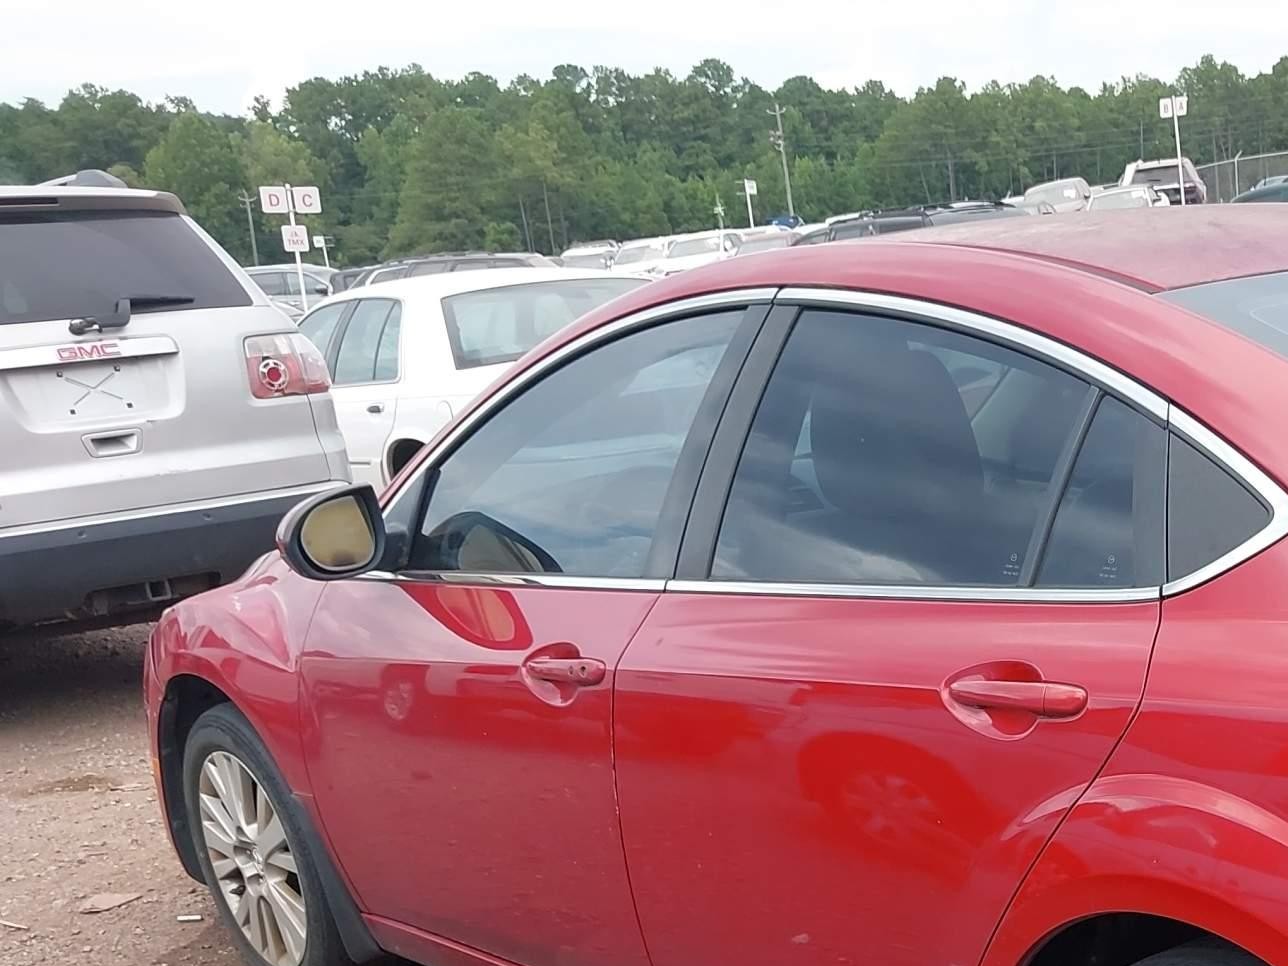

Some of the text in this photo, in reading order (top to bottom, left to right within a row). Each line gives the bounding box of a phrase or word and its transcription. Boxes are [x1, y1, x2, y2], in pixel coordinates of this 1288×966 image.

[268, 193, 280, 207] D
[302, 193, 313, 207] C
[57, 343, 122, 361] GMC
